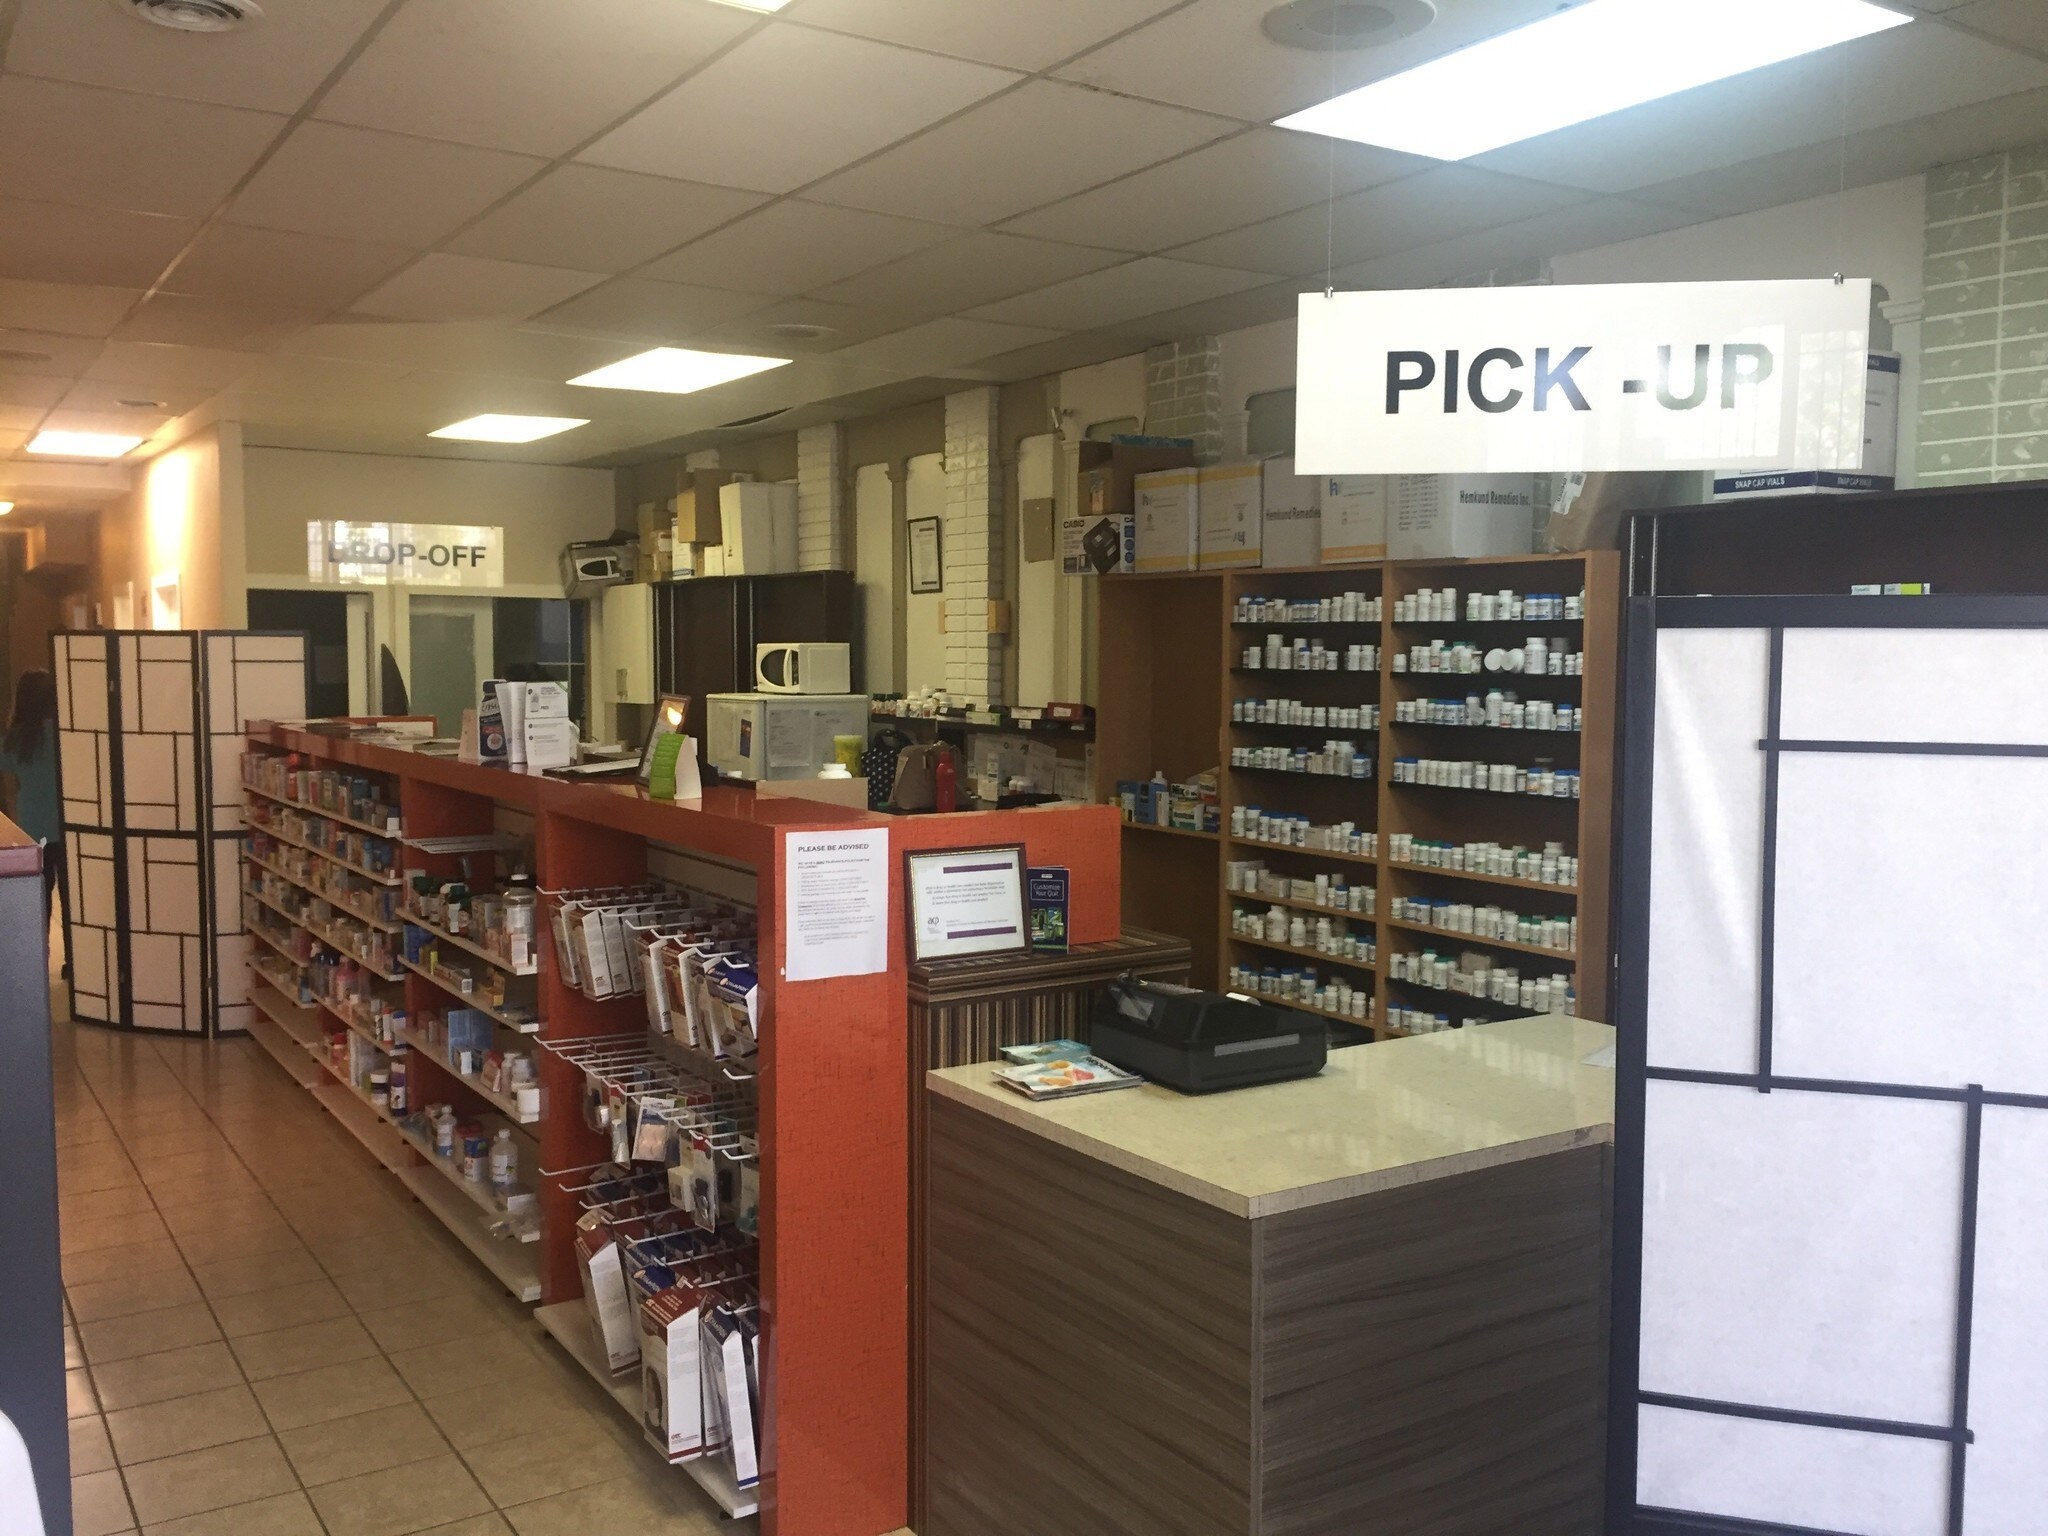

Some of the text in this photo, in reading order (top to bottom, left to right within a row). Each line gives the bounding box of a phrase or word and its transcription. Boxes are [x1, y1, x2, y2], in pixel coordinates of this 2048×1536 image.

[1385, 342, 1775, 415] PICK -UP
[1735, 476, 1785, 489] SNAP CAP VIALS
[1063, 519, 1085, 529] CASIO
[328, 541, 487, 568] DROP-OFF
[798, 845, 826, 853] PLEASE
[837, 843, 870, 851] ADVISED
